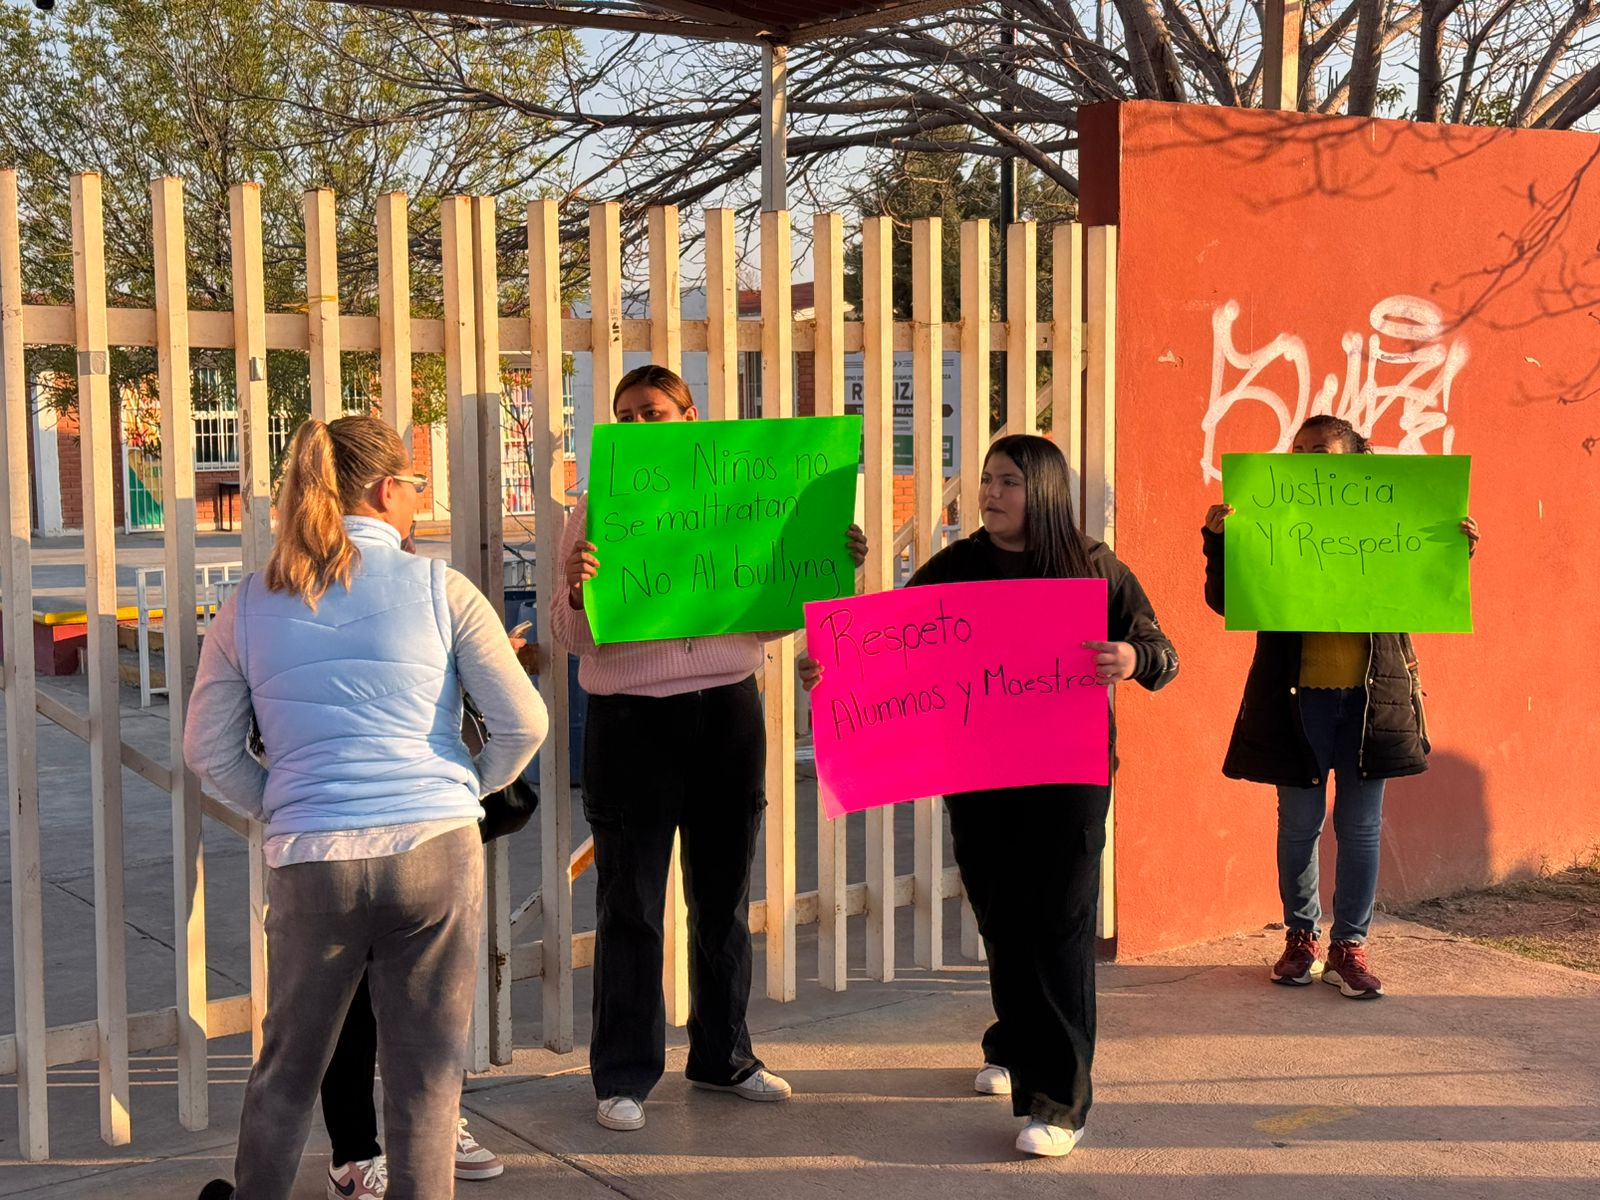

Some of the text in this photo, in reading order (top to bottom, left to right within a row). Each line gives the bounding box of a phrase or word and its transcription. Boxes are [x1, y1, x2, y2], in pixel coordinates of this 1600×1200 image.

[609, 439, 829, 497] Los Niños no
[1252, 464, 1395, 509] Justicia
[604, 491, 799, 543] Se maltratan
[621, 538, 841, 608] No Al bullyng
[1255, 521, 1422, 576] Y Respeto
[819, 599, 973, 682] Respeto
[831, 685, 947, 741] Alumnos
[956, 680, 972, 728] y
